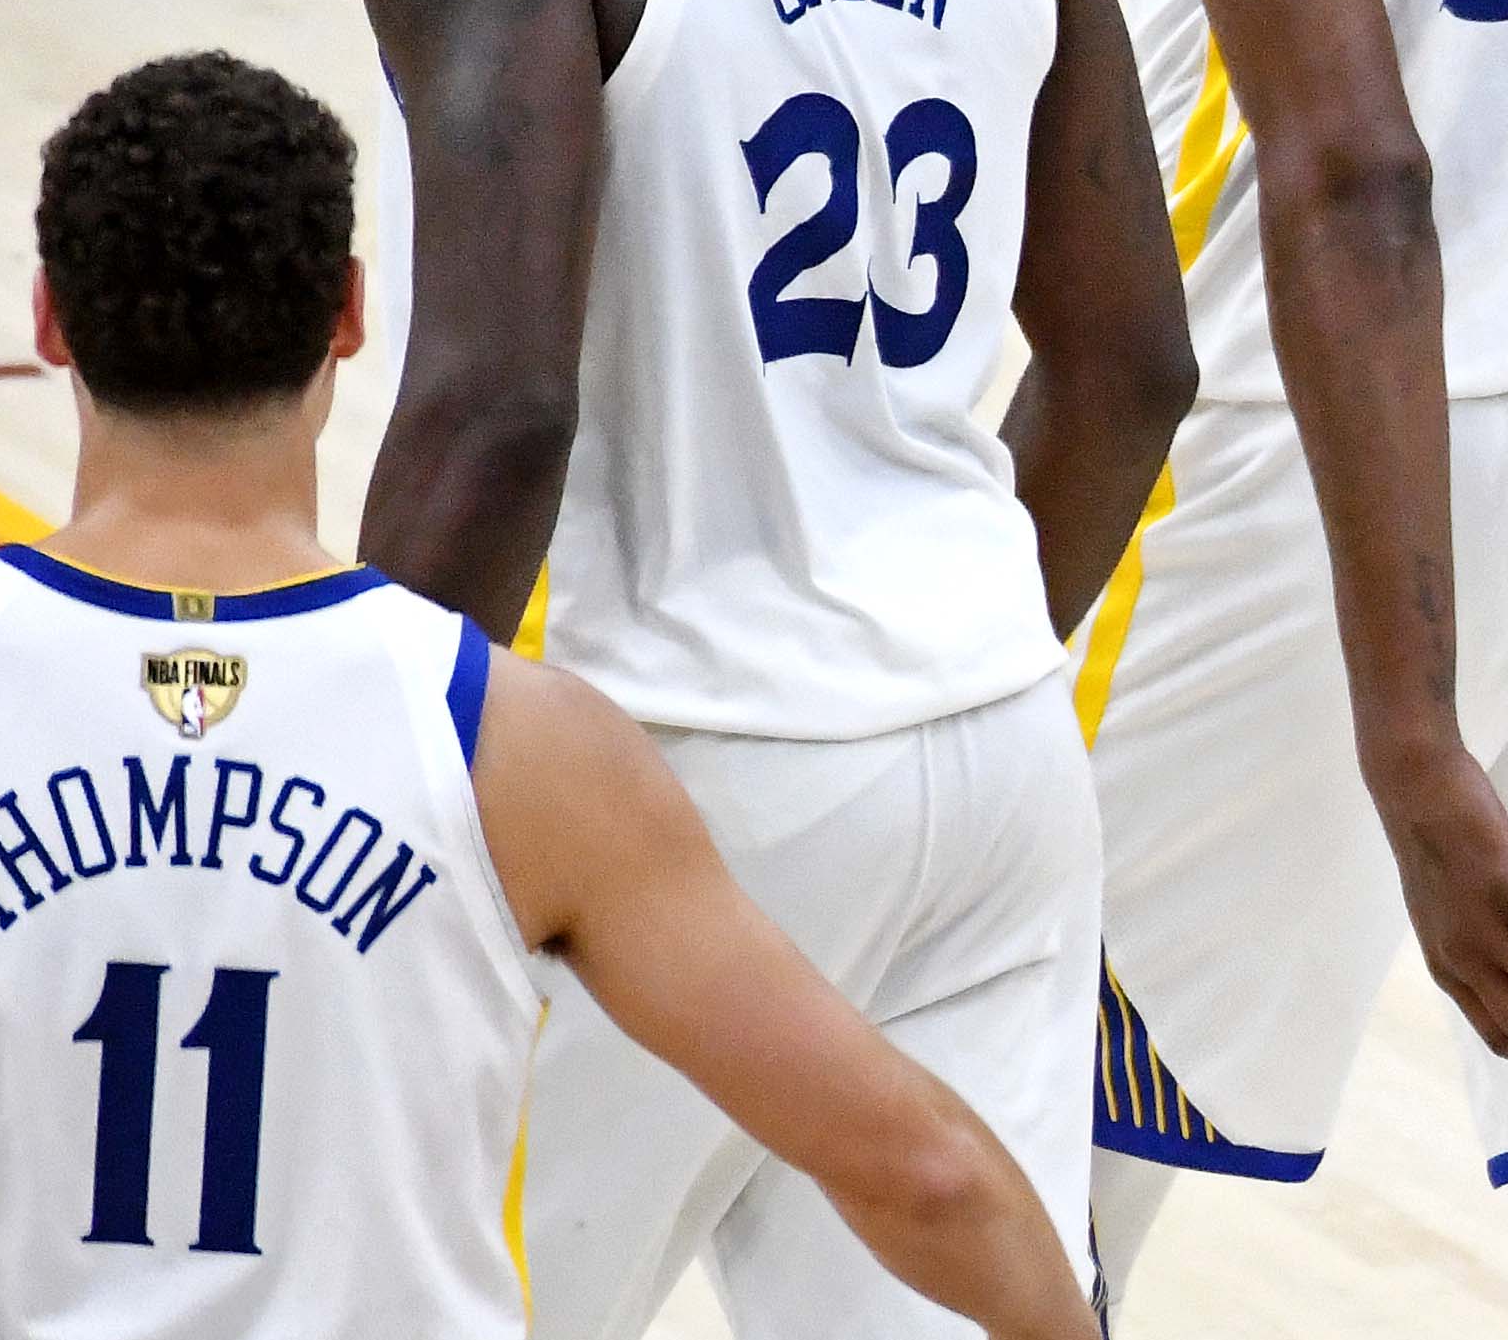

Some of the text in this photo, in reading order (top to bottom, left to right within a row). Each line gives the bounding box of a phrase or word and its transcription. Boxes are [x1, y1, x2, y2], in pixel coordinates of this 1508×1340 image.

[739, 92, 978, 369] 23
[147, 659, 241, 687] NBA FINALS
[72, 961, 280, 1256] 11
